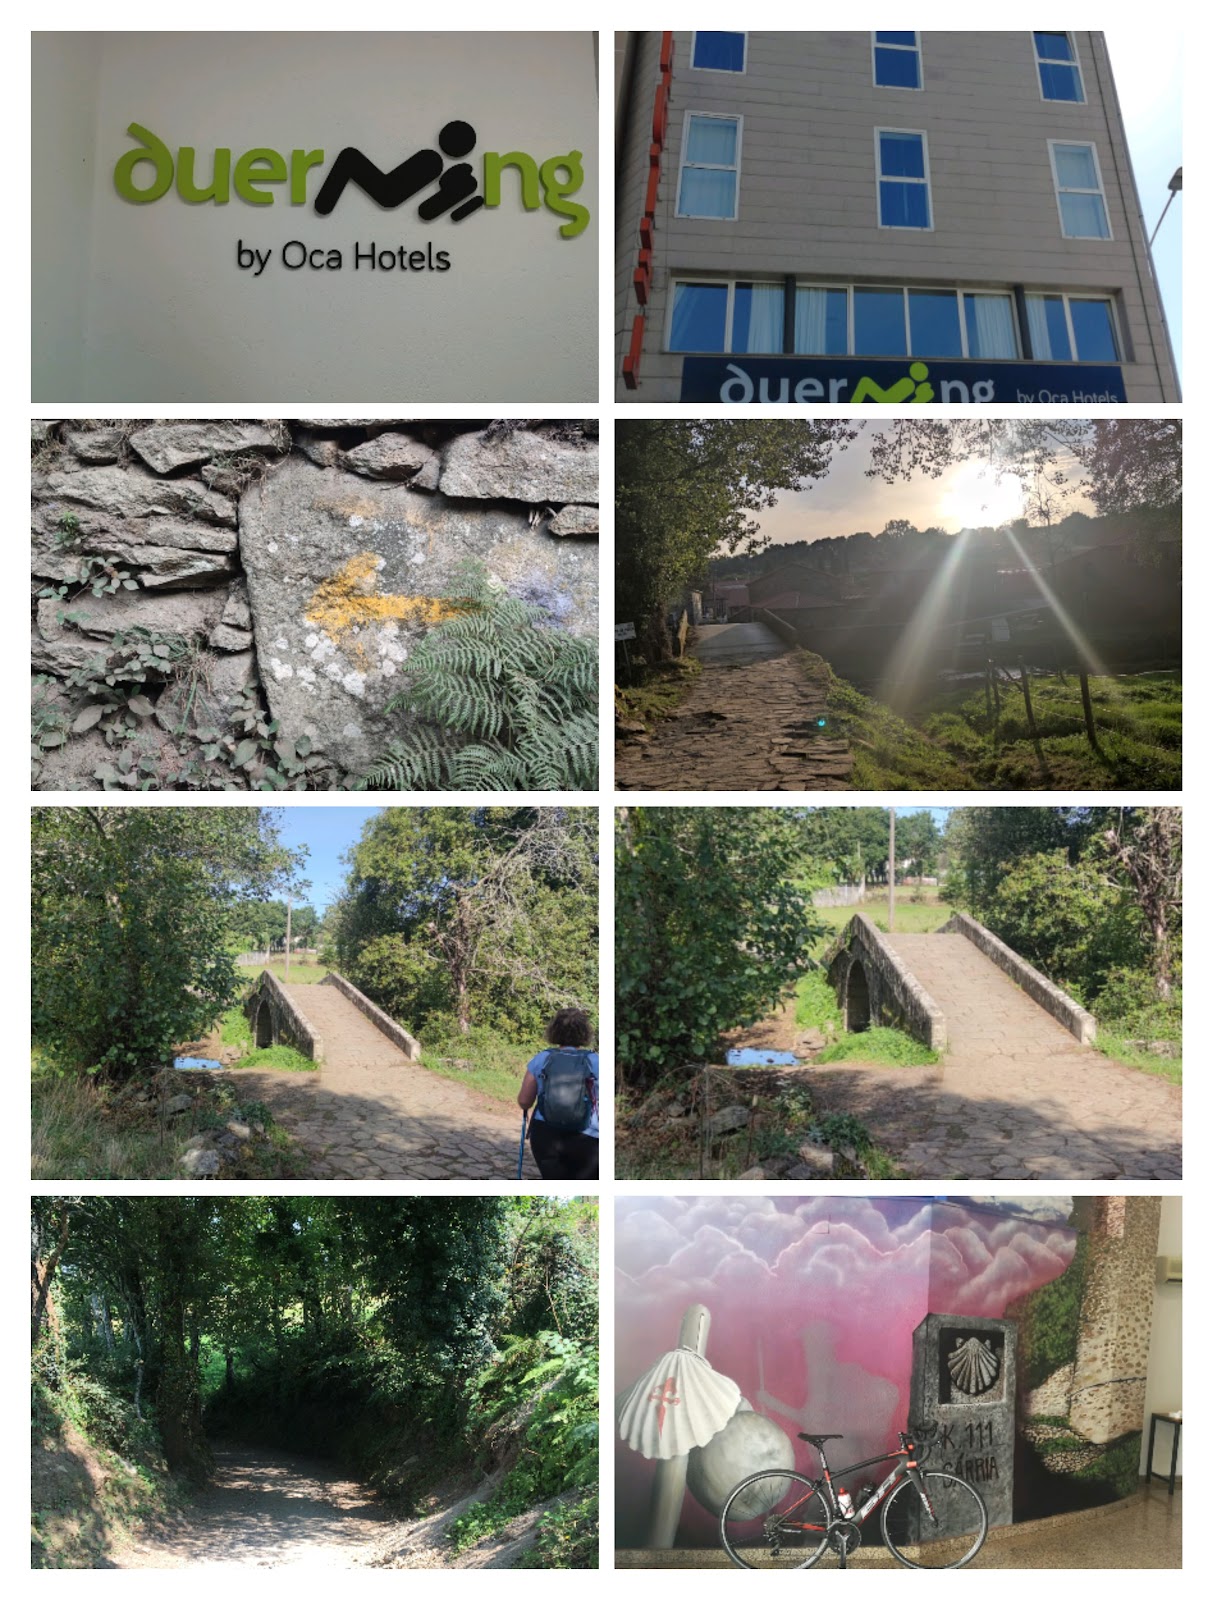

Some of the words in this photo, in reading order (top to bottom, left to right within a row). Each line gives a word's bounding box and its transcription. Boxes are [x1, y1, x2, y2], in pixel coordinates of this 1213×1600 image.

[236, 239, 272, 277] by
[282, 240, 343, 270] Oca
[354, 241, 452, 271] Hotels
[1072, 390, 1119, 403] Hotels
